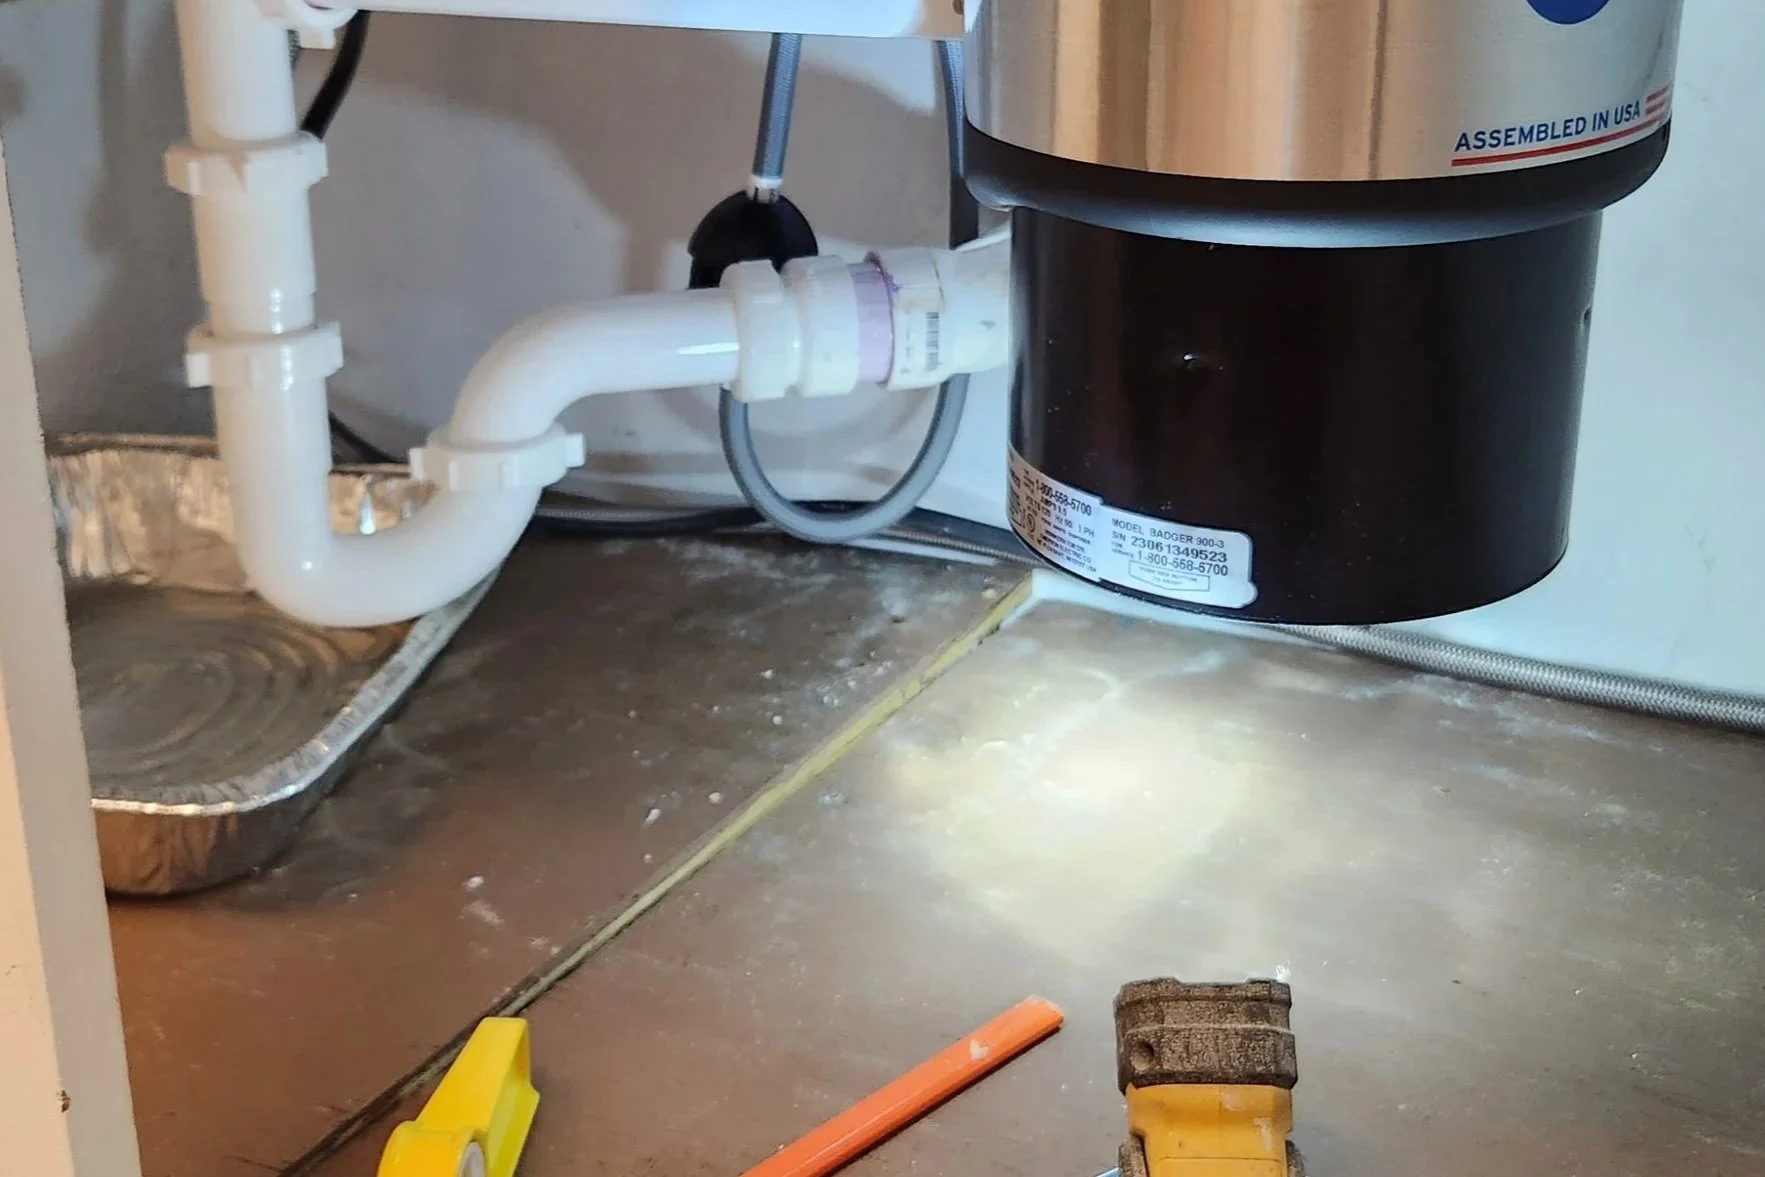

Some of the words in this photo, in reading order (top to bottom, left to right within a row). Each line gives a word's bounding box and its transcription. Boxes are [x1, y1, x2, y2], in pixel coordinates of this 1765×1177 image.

[1454, 116, 1585, 152] ASSEMBLED
[1592, 112, 1610, 132] IN
[1614, 100, 1641, 126] USA
[1083, 527, 1095, 537] PH
[1112, 518, 1144, 535] MODEL
[1149, 528, 1194, 544] BADGER
[1195, 536, 1224, 549] 900-3
[1131, 535, 1228, 563] 23061349523
[1138, 550, 1229, 577] 1-800-558-5700
